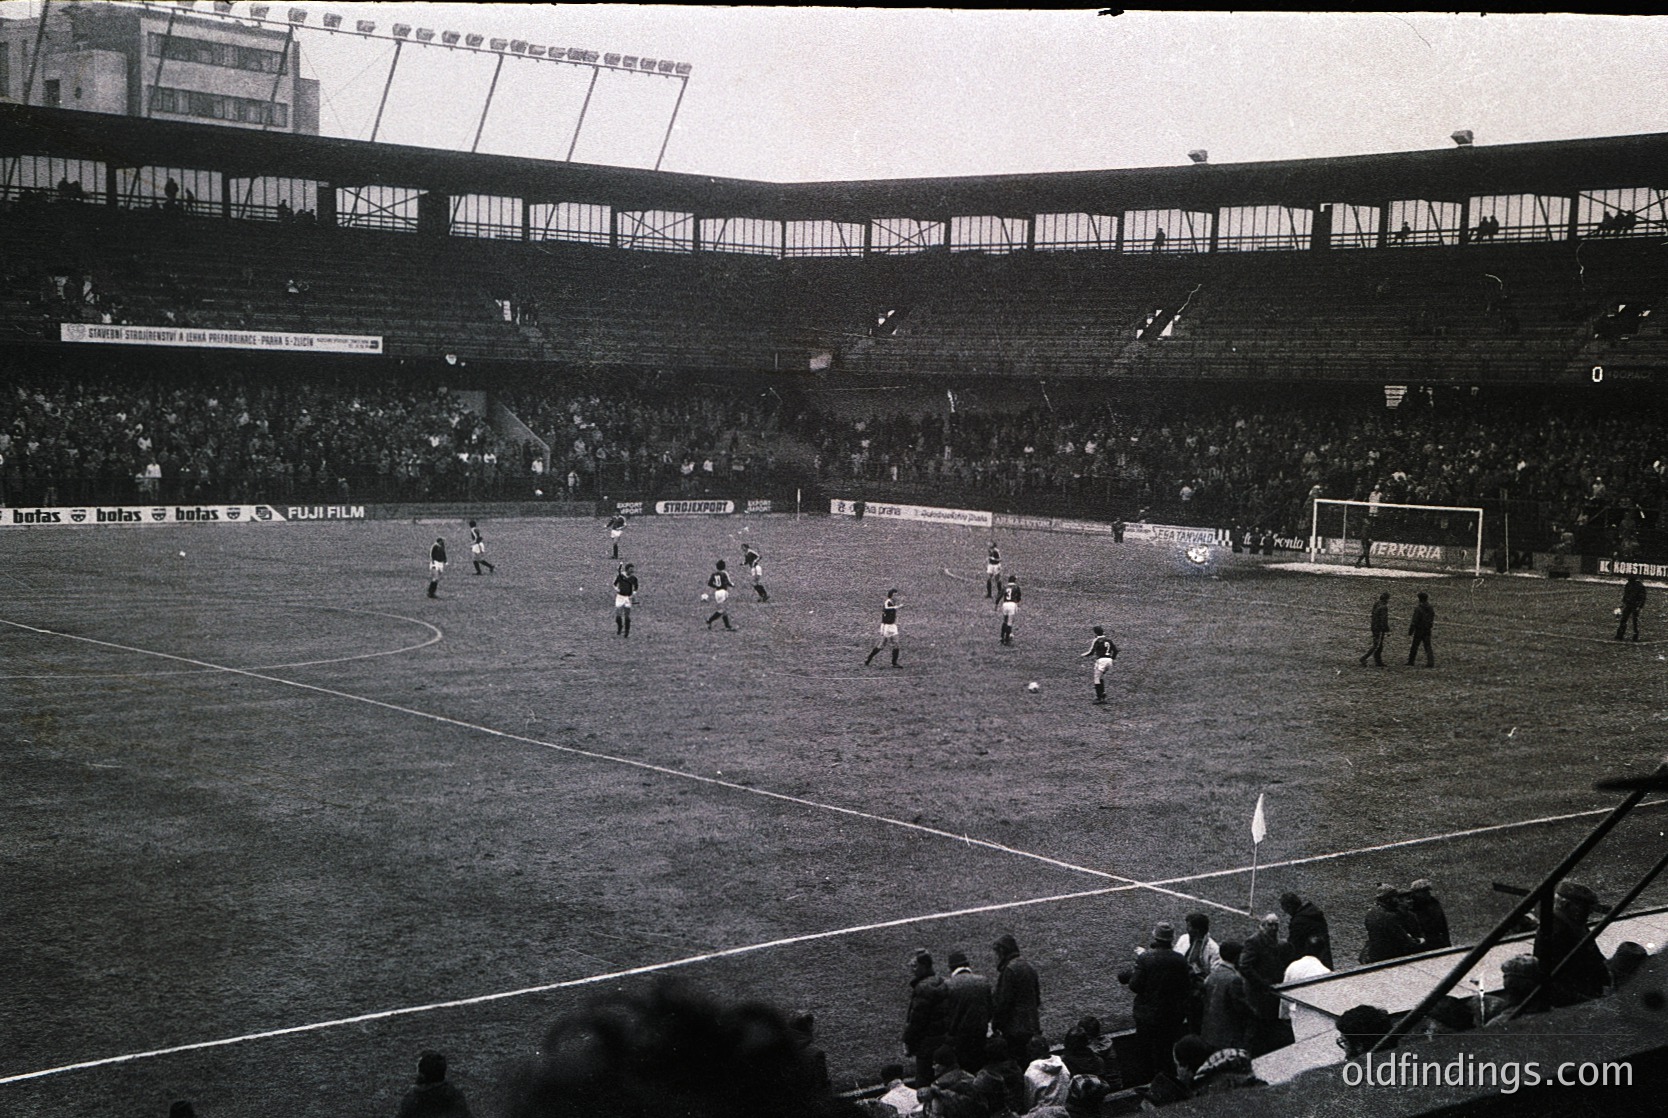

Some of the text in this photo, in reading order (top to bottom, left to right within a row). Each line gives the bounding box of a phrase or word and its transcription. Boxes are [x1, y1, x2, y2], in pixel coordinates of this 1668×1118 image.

[179, 332, 184, 341] A
[175, 507, 219, 521] botas
[287, 506, 365, 519] FUJI FILM
[663, 502, 728, 513] STROJEXPORT
[878, 506, 901, 516] praha
[13, 509, 61, 524] botas
[96, 508, 142, 522] botas
[1613, 561, 1668, 577] KONSTRUKT
